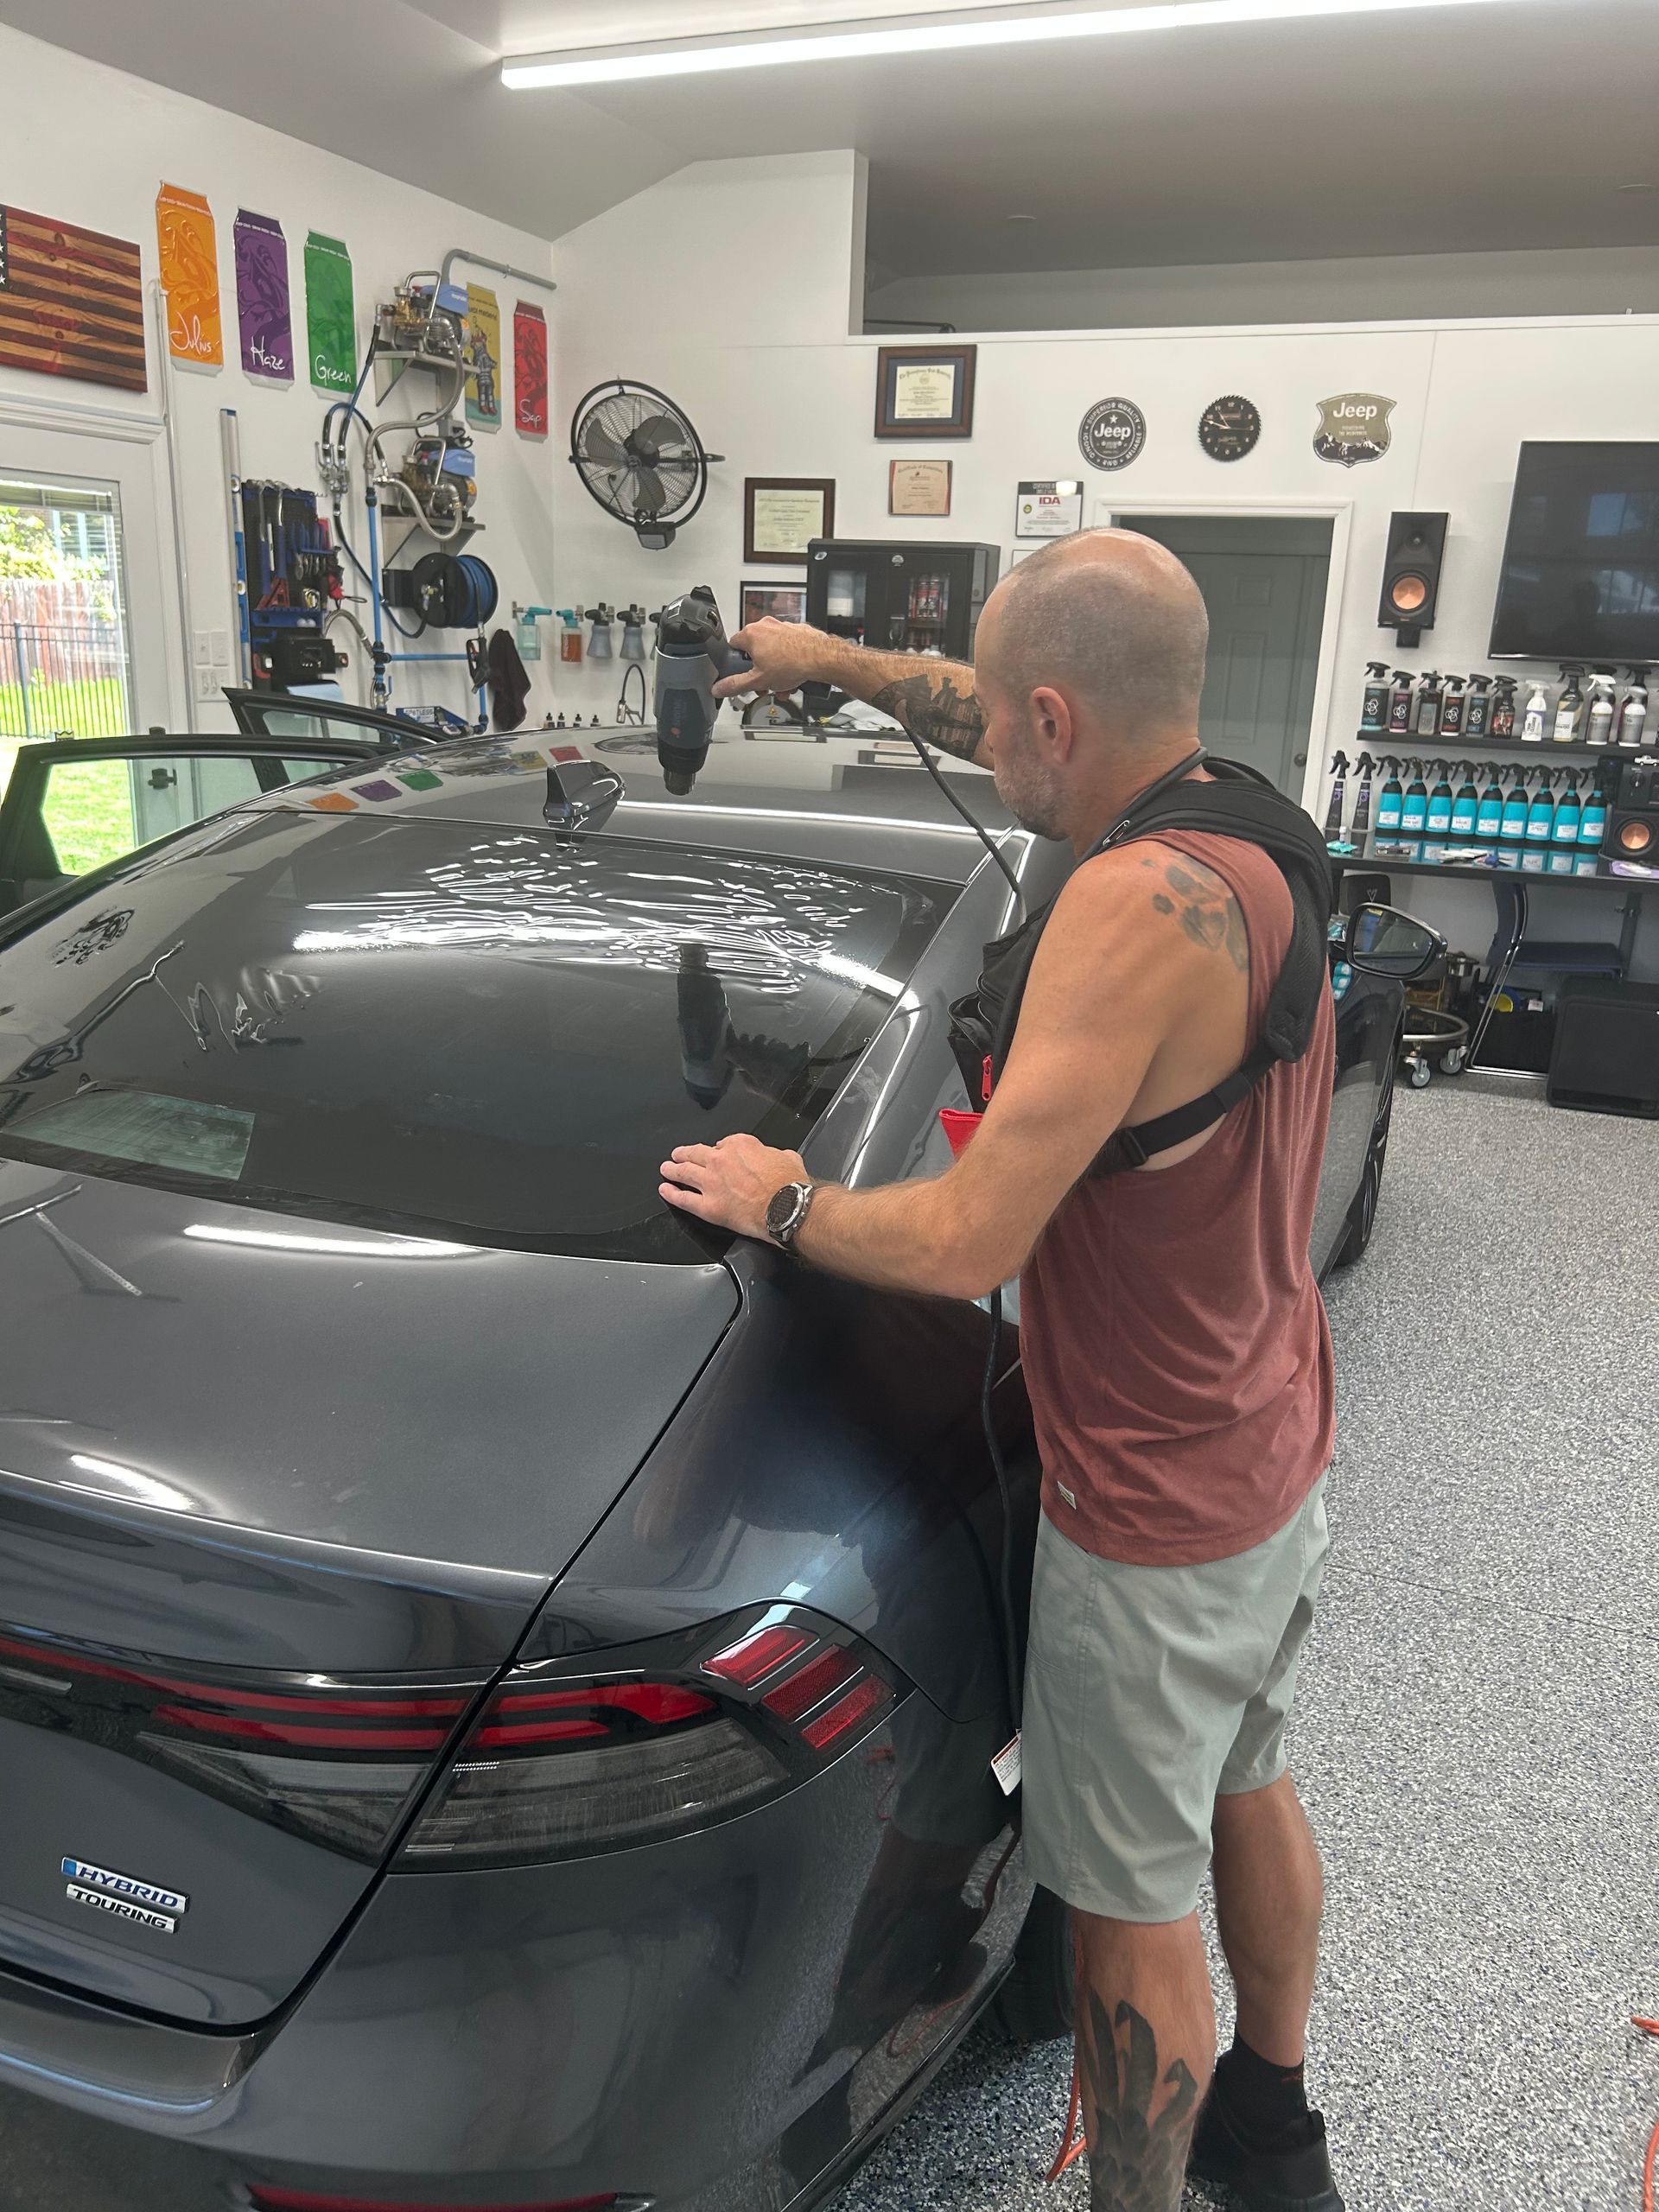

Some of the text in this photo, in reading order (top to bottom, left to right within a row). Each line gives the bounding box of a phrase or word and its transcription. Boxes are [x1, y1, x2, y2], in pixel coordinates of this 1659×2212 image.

[169, 311, 212, 356] Julius
[251, 335, 286, 372] Haze
[315, 354, 353, 386] Green
[519, 397, 542, 429] Sap
[1087, 402, 1141, 424] SUPERIOR QUALITY
[1332, 402, 1377, 420] Jeep
[1094, 423, 1131, 441] Jeep
[1039, 497, 1061, 505] IDA
[79, 1866, 178, 1908] HYBRID
[73, 1889, 168, 1929] TOURING
